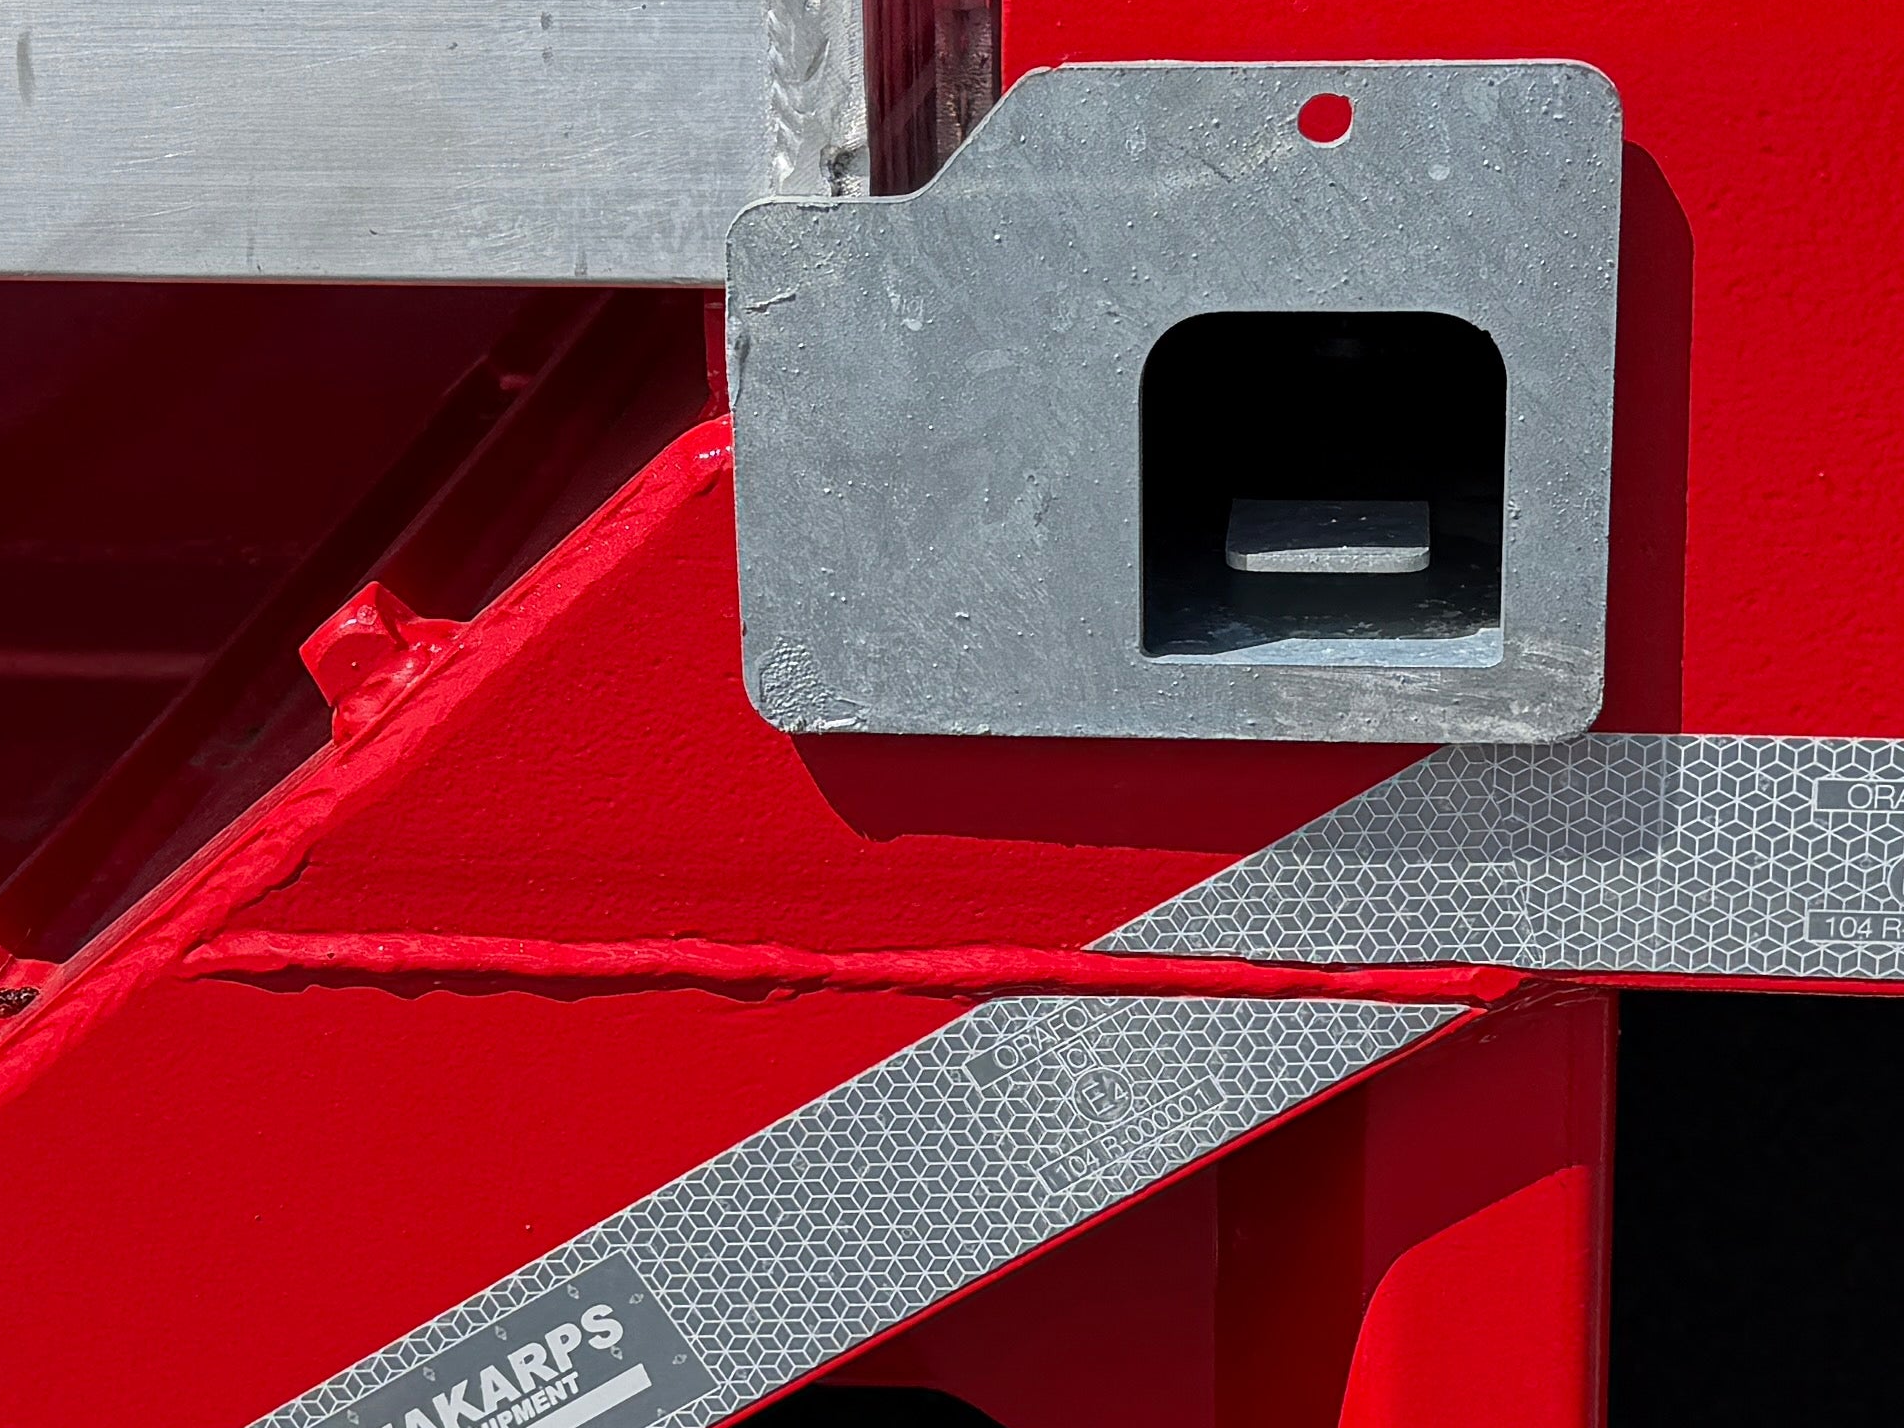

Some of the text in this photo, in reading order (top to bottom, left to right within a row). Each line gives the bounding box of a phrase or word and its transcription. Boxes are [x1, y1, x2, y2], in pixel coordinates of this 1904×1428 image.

[1824, 916, 1873, 940] 104
[1056, 1087, 1212, 1182] 104 R-000001
